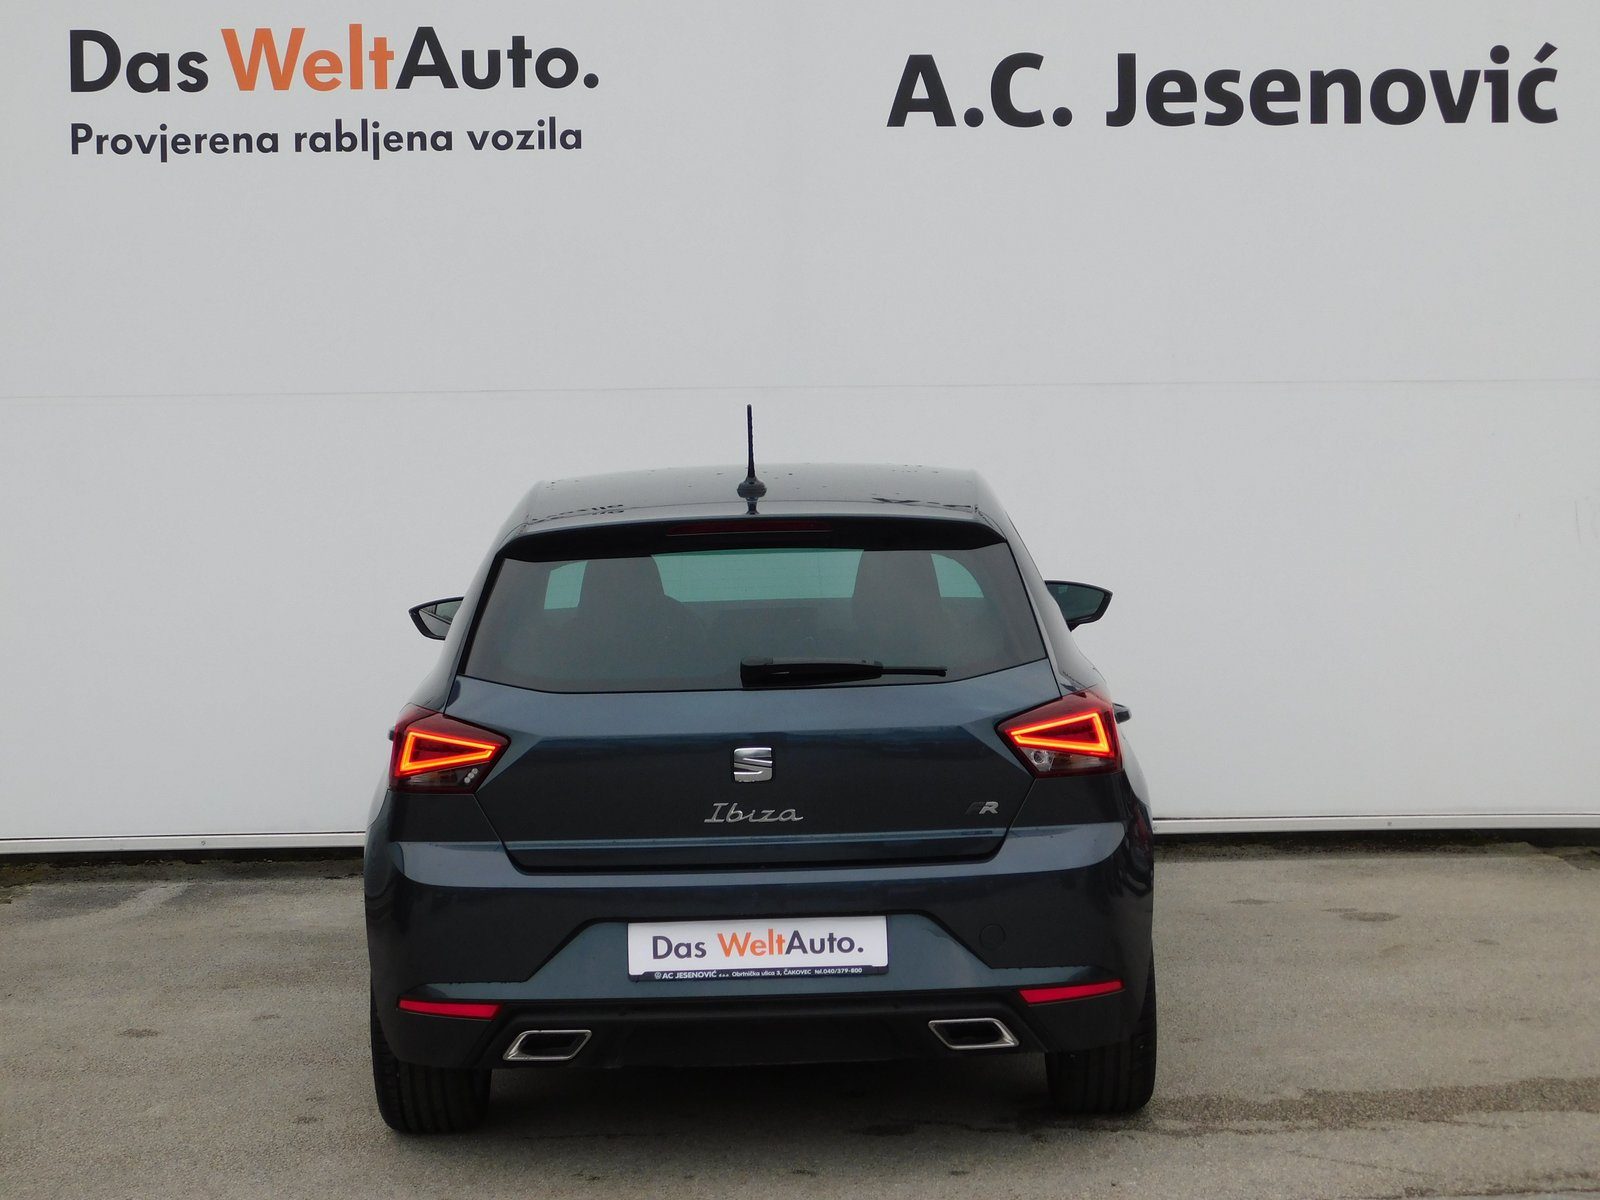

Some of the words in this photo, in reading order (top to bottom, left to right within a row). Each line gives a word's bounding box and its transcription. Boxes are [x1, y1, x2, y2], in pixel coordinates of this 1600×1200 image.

[70, 29, 209, 94] Das
[220, 23, 600, 92] WeltAuto.
[886, 51, 1073, 128] A.C.
[1105, 41, 1559, 128] Jesenović
[70, 122, 279, 163] Provjerena
[294, 118, 453, 161] rabljena
[466, 116, 582, 151] vozila
[704, 803, 804, 823] Ibiza
[652, 935, 707, 960] Das
[717, 928, 864, 958] WeltAuto.
[662, 971, 674, 979] AC
[675, 970, 717, 979] JESENOVIĆ
[783, 968, 812, 976] ČAKOVEC
